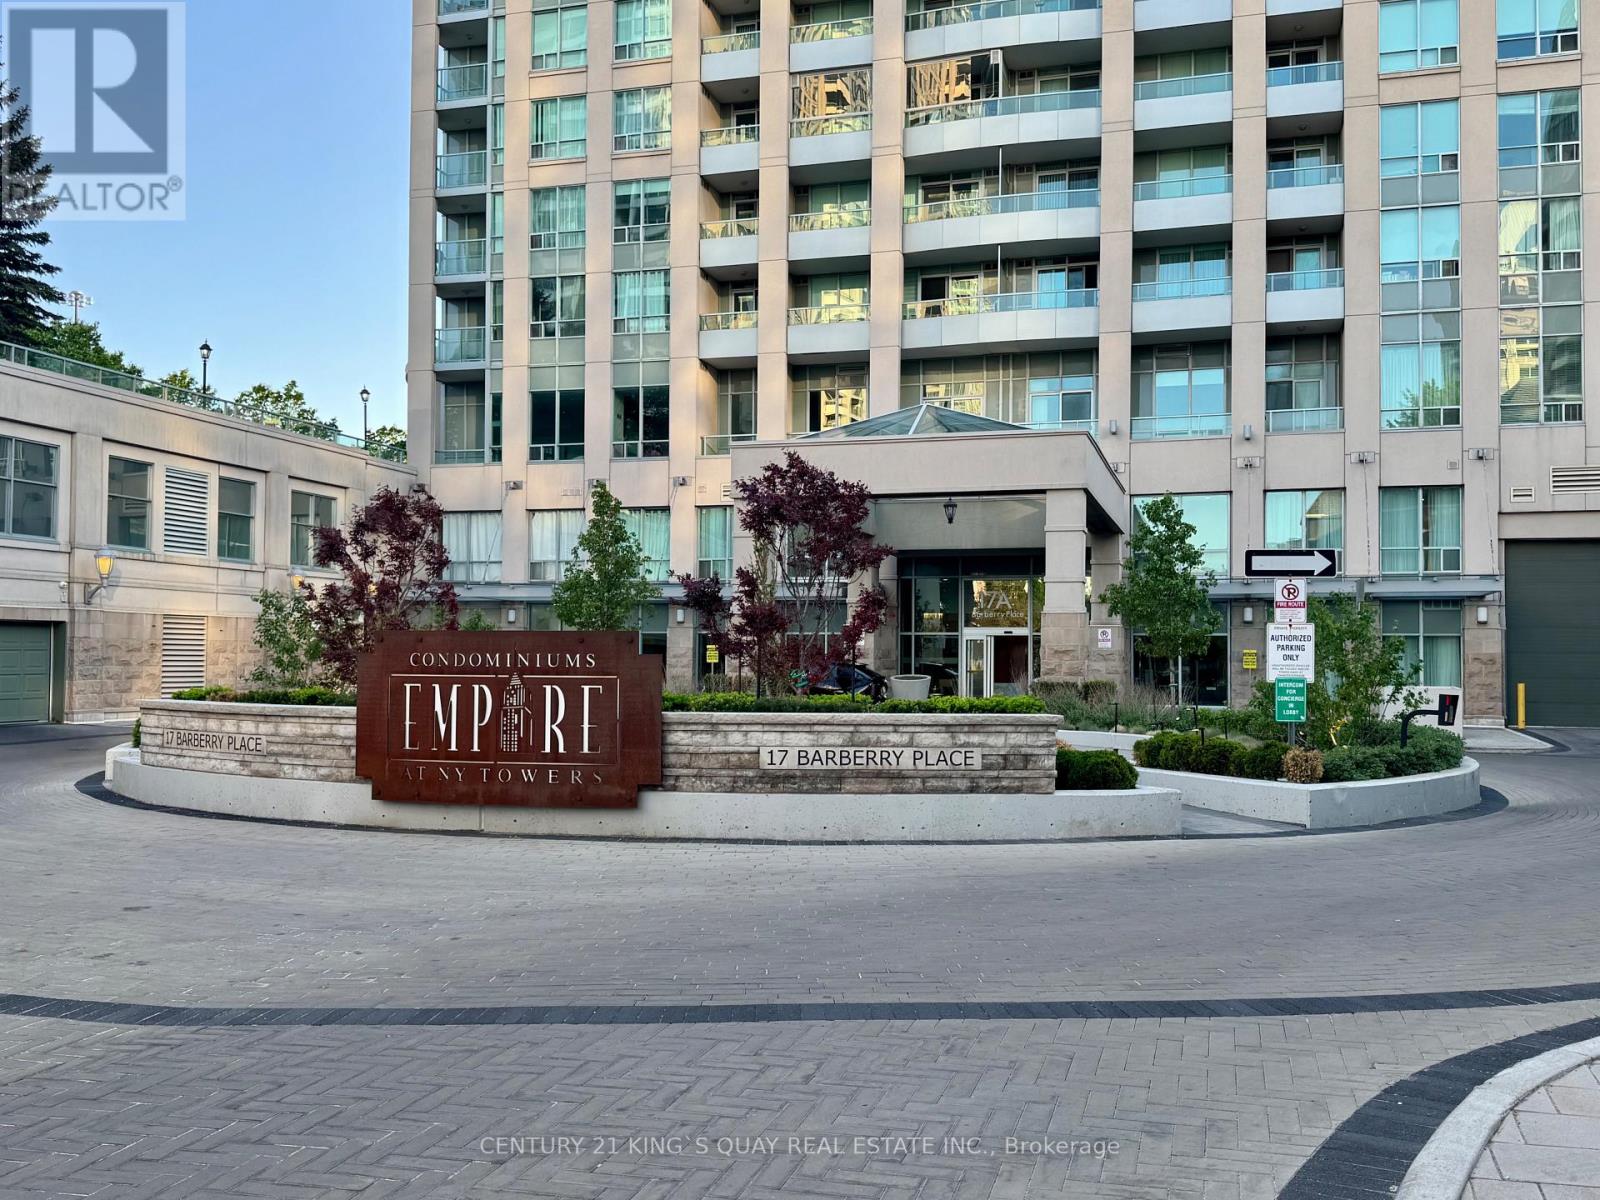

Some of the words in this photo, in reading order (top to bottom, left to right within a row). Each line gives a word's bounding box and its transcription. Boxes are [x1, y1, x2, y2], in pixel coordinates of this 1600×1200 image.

[979, 590, 1012, 608] 17A
[1270, 634, 1312, 642] AUTHORIZED
[409, 652, 596, 669] CONDOMINIUMS
[165, 730, 175, 745] 17
[176, 731, 224, 750] BARBERRY
[227, 735, 262, 752] PLACE
[767, 749, 788, 766] 17
[797, 749, 904, 767] BARBERRY
[912, 750, 975, 767] PLACE
[404, 766, 426, 781] AT
[437, 767, 465, 782] NY
[479, 767, 602, 784] TOWERS
